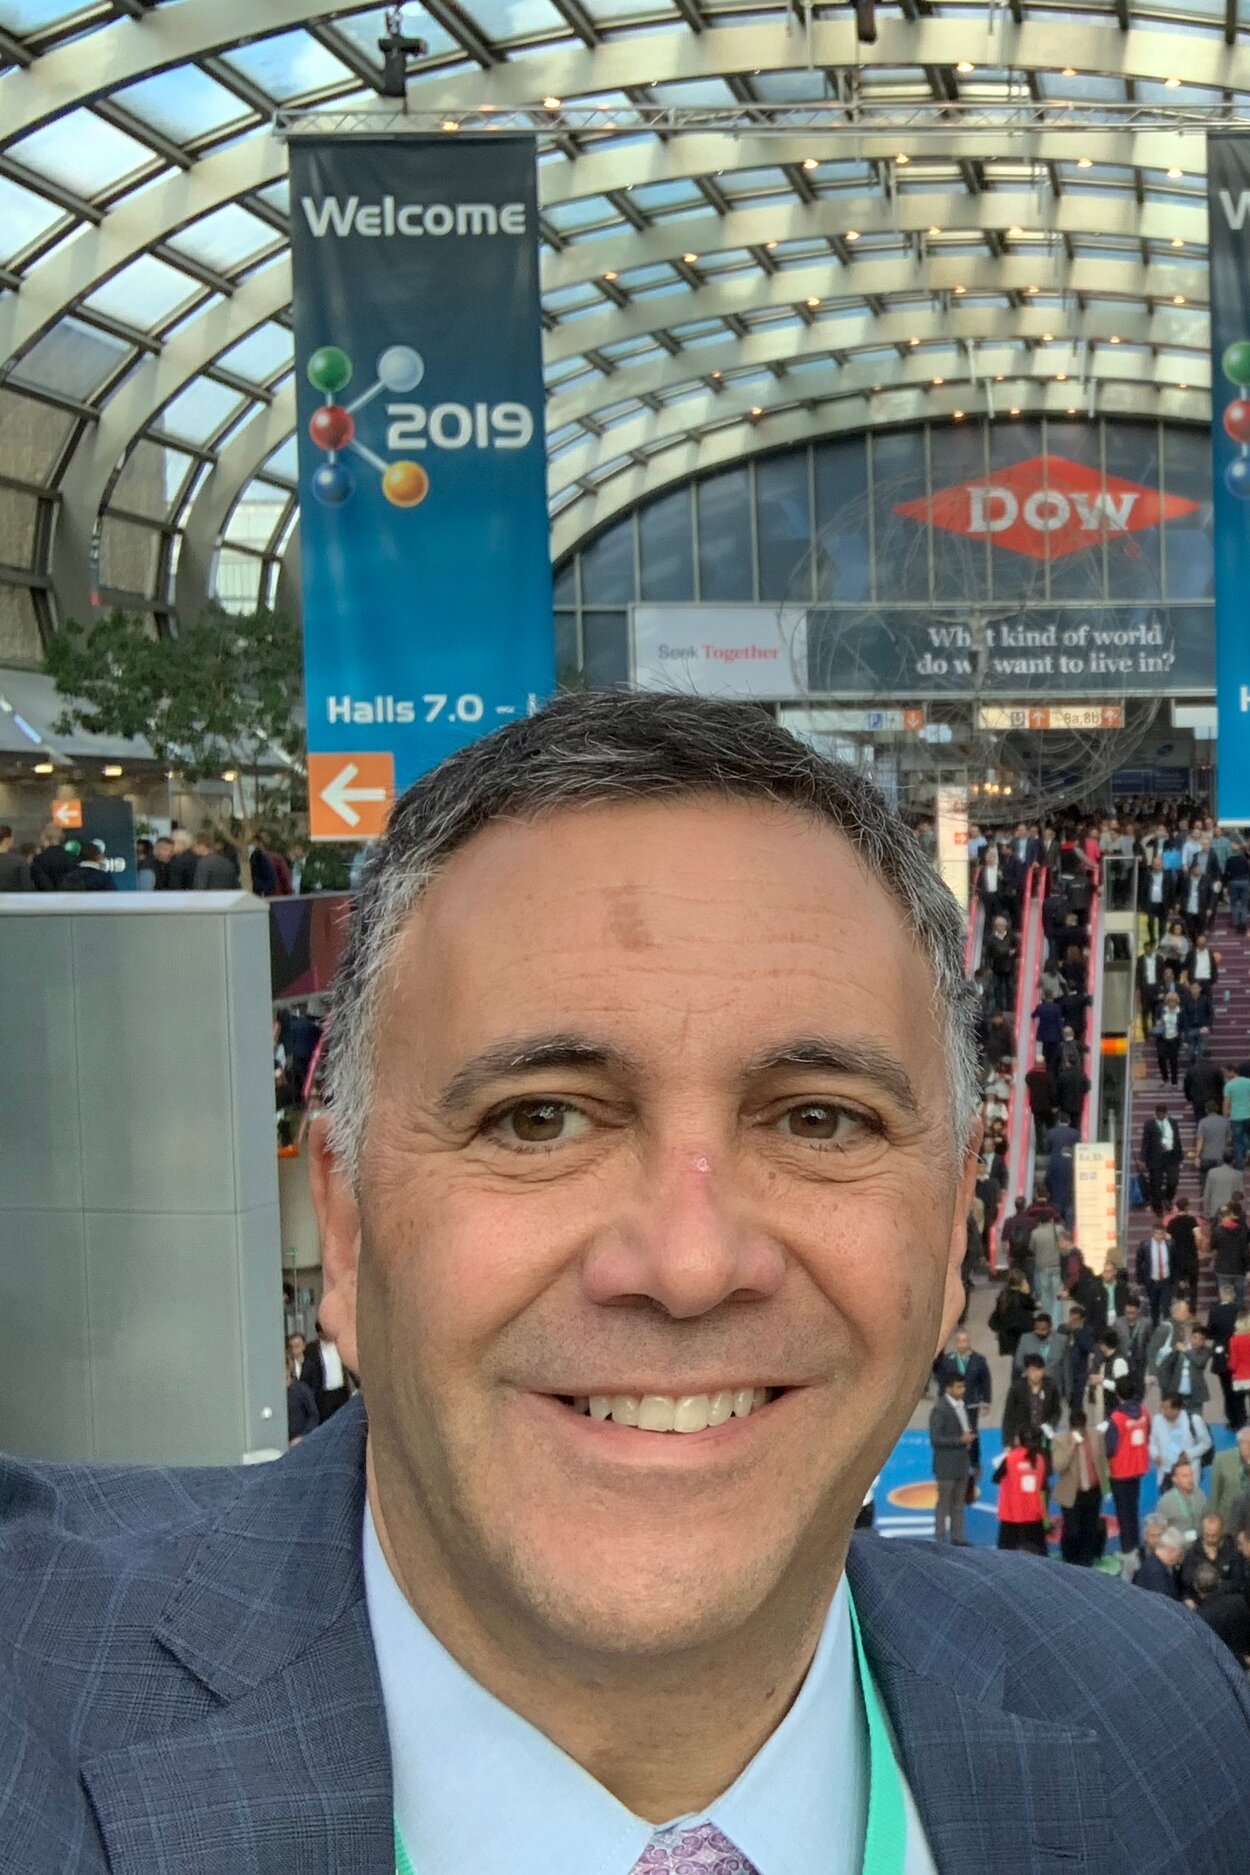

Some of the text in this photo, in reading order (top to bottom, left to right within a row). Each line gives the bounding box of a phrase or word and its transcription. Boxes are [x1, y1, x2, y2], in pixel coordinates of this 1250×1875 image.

[302, 195, 527, 238] Welcome
[386, 402, 534, 451] 2019
[928, 623, 1164, 648] Wht kind of world
[658, 644, 779, 663] Seek Together
[916, 653, 948, 675] do
[995, 656, 1054, 675] want
[1059, 656, 1084, 675] to
[1090, 653, 1134, 673] live
[1138, 652, 1175, 674] in?
[327, 695, 416, 724] Halls
[423, 693, 484, 723] 7.0
